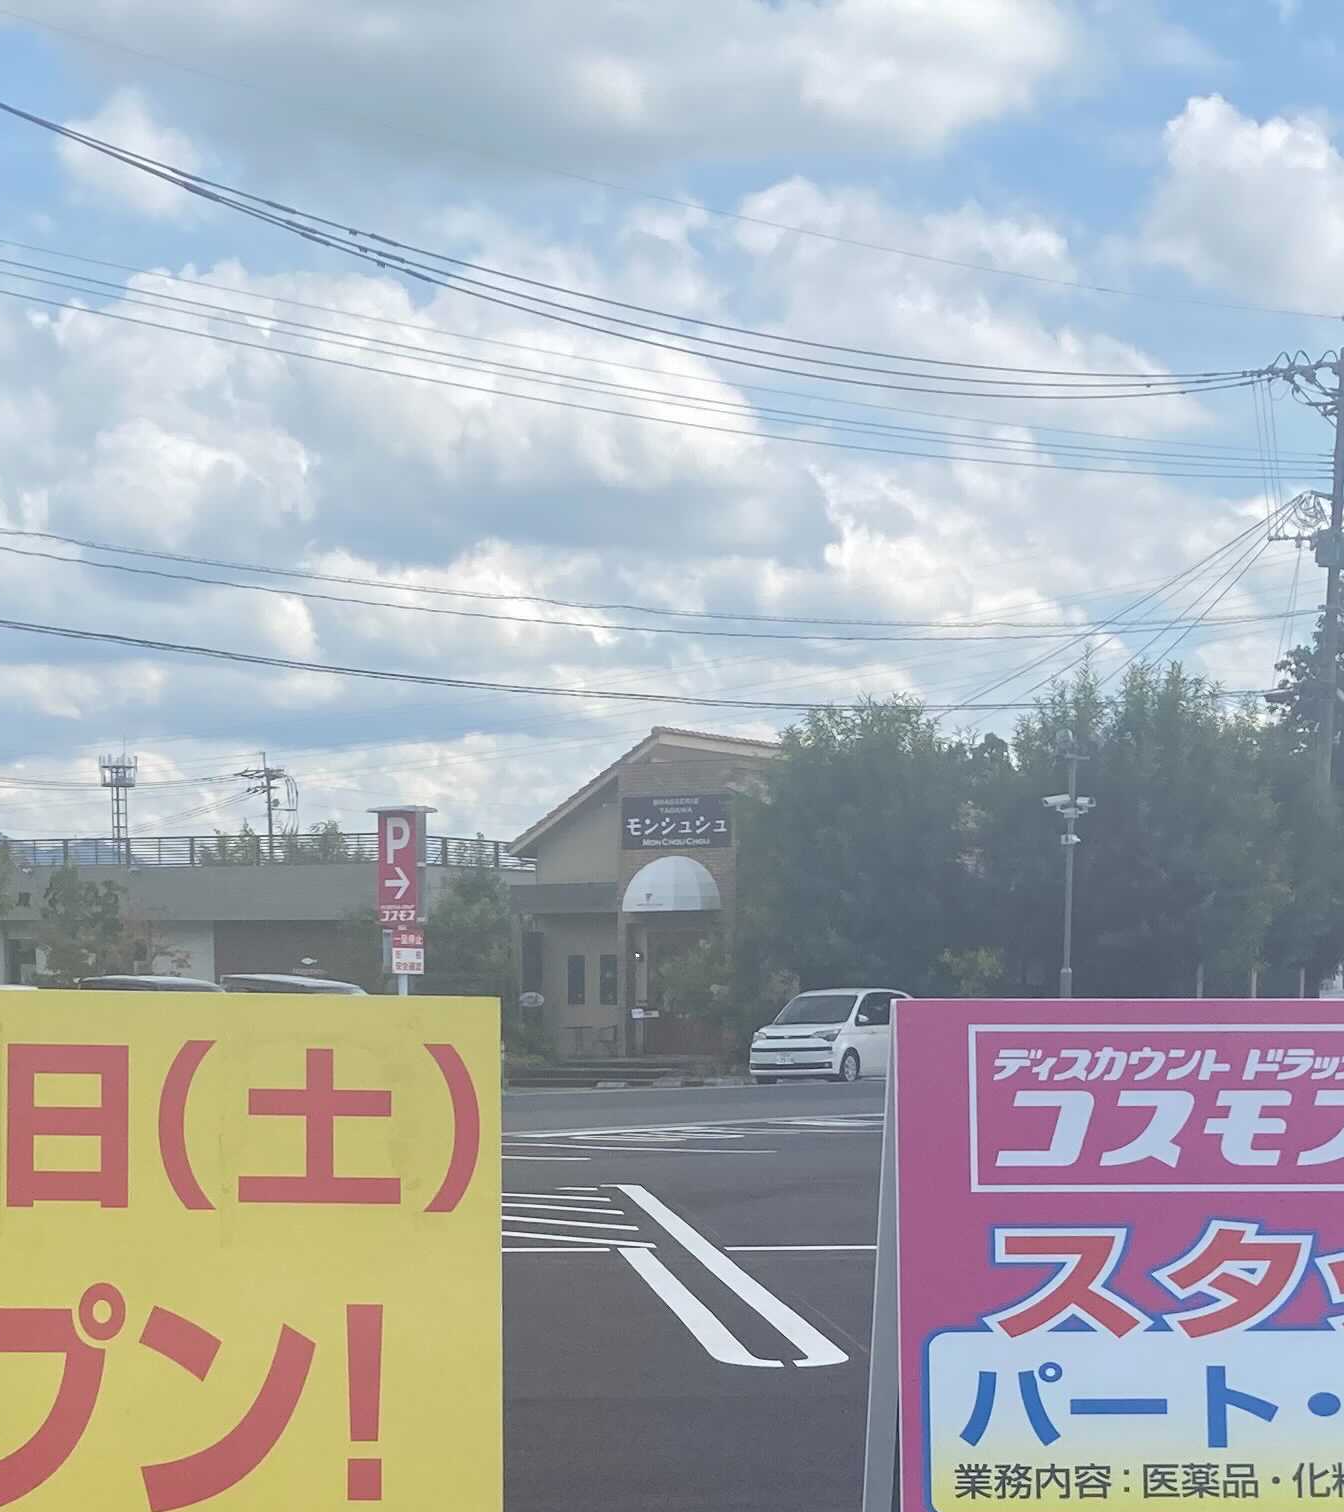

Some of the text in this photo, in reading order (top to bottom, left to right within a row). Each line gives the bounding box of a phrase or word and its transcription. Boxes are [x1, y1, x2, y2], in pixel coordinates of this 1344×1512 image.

[626, 816, 727, 835] モンシュシュ
[386, 816, 410, 864] P
[380, 910, 416, 921] コスモス
[993, 1047, 1231, 1082] ディスカウント
